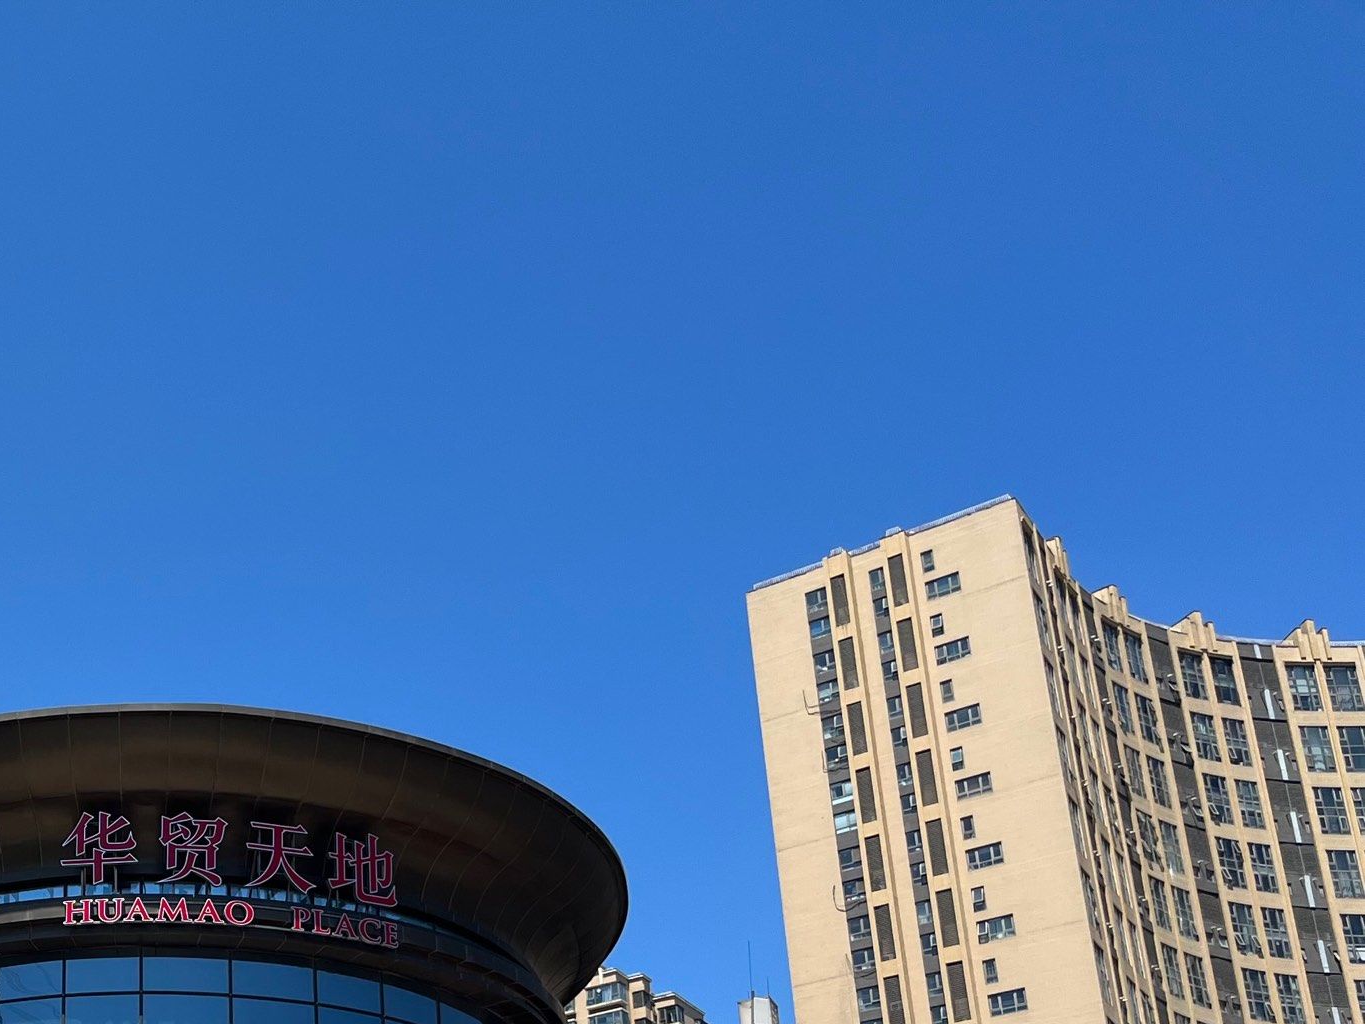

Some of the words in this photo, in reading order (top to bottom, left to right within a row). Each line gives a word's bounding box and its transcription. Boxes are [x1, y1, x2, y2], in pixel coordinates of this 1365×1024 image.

[60, 811, 398, 907] 华贸天地
[63, 896, 255, 926] HUAMAO
[291, 905, 401, 949] PLACE
